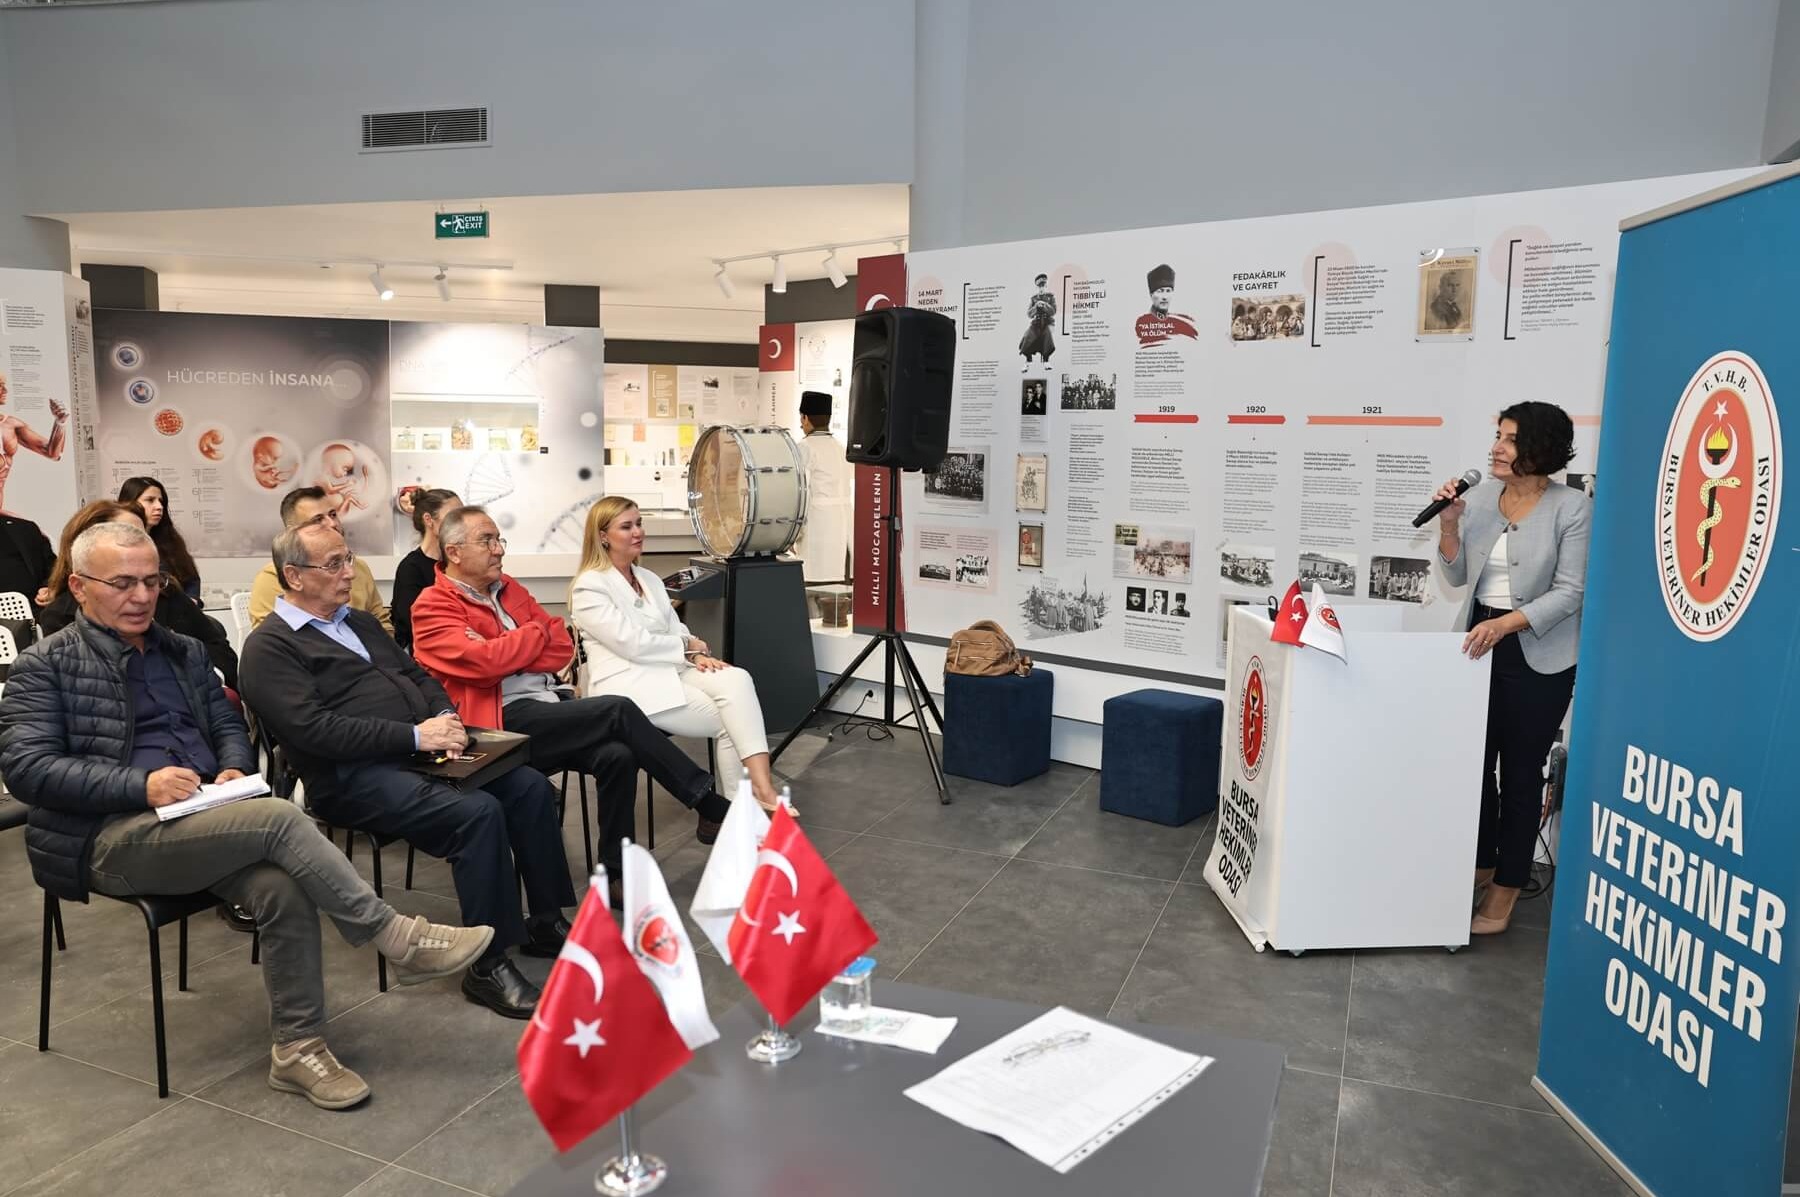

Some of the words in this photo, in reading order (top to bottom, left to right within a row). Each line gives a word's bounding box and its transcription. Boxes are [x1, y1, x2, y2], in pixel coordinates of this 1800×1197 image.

[1073, 290, 1106, 299] TIBBİYELİ
[1232, 283, 1243, 291] VE
[1245, 282, 1279, 291] GAYRET
[1233, 270, 1287, 281] FEDAKÂRLIK
[1072, 301, 1099, 310] HİKMET
[167, 367, 264, 385] HÜCREDEN
[1158, 405, 1176, 413] 1919
[1362, 406, 1382, 414] 1921
[1662, 454, 1679, 520] BURSA
[1754, 455, 1770, 525] ODASI
[871, 473, 881, 566] MÜCADELENİN
[871, 571, 880, 606] MİLLİ
[1662, 524, 1701, 626] VETERİNER
[1705, 532, 1762, 626] HEKİMLER
[1231, 779, 1259, 825] BURSA
[1622, 744, 1743, 857] BURSA
[1218, 821, 1252, 883] HEKİMLER
[1218, 854, 1242, 899] ODASI
[1592, 801, 1787, 966] VETERİNER
[1584, 870, 1767, 1043] HEKİMLER
[1604, 957, 1715, 1089] ODASI
